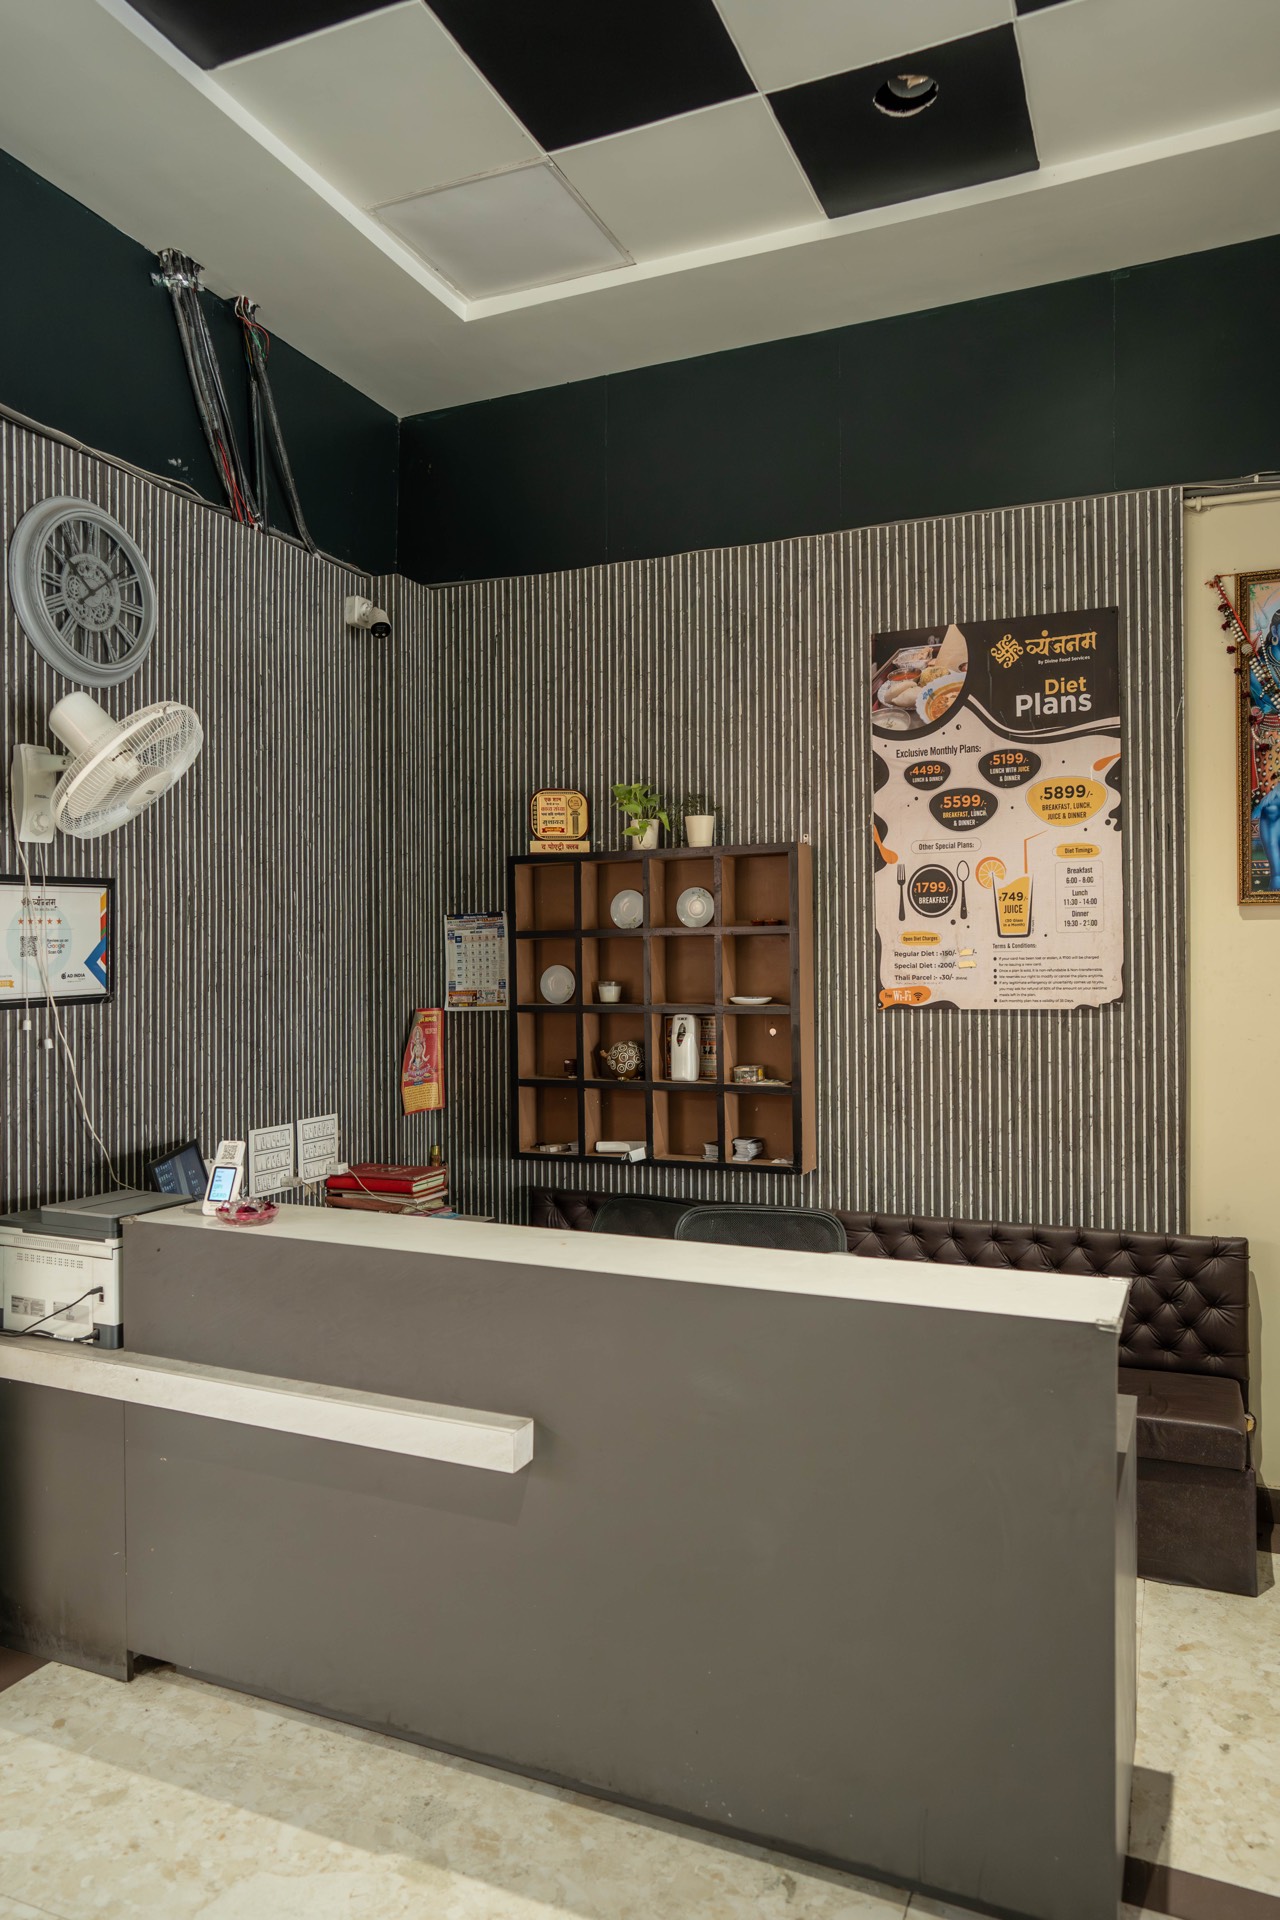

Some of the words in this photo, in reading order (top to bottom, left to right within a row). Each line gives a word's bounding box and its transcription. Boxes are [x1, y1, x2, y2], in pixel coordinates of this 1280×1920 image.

[1024, 630, 1098, 656] व्यंजनम
[1045, 676, 1087, 695] Diet
[1016, 692, 1092, 717] Plans
[896, 748, 928, 758] Exclusive
[930, 746, 958, 758] Monthly
[960, 744, 982, 754] Plans:
[1042, 803, 1072, 811] BREAKFAST,
[548, 842, 564, 851] पोएट्री
[935, 842, 956, 851] Special
[918, 896, 949, 904] BREAKFAST
[1004, 904, 1023, 914] JUICE
[893, 990, 911, 1001] Wi-Fi
